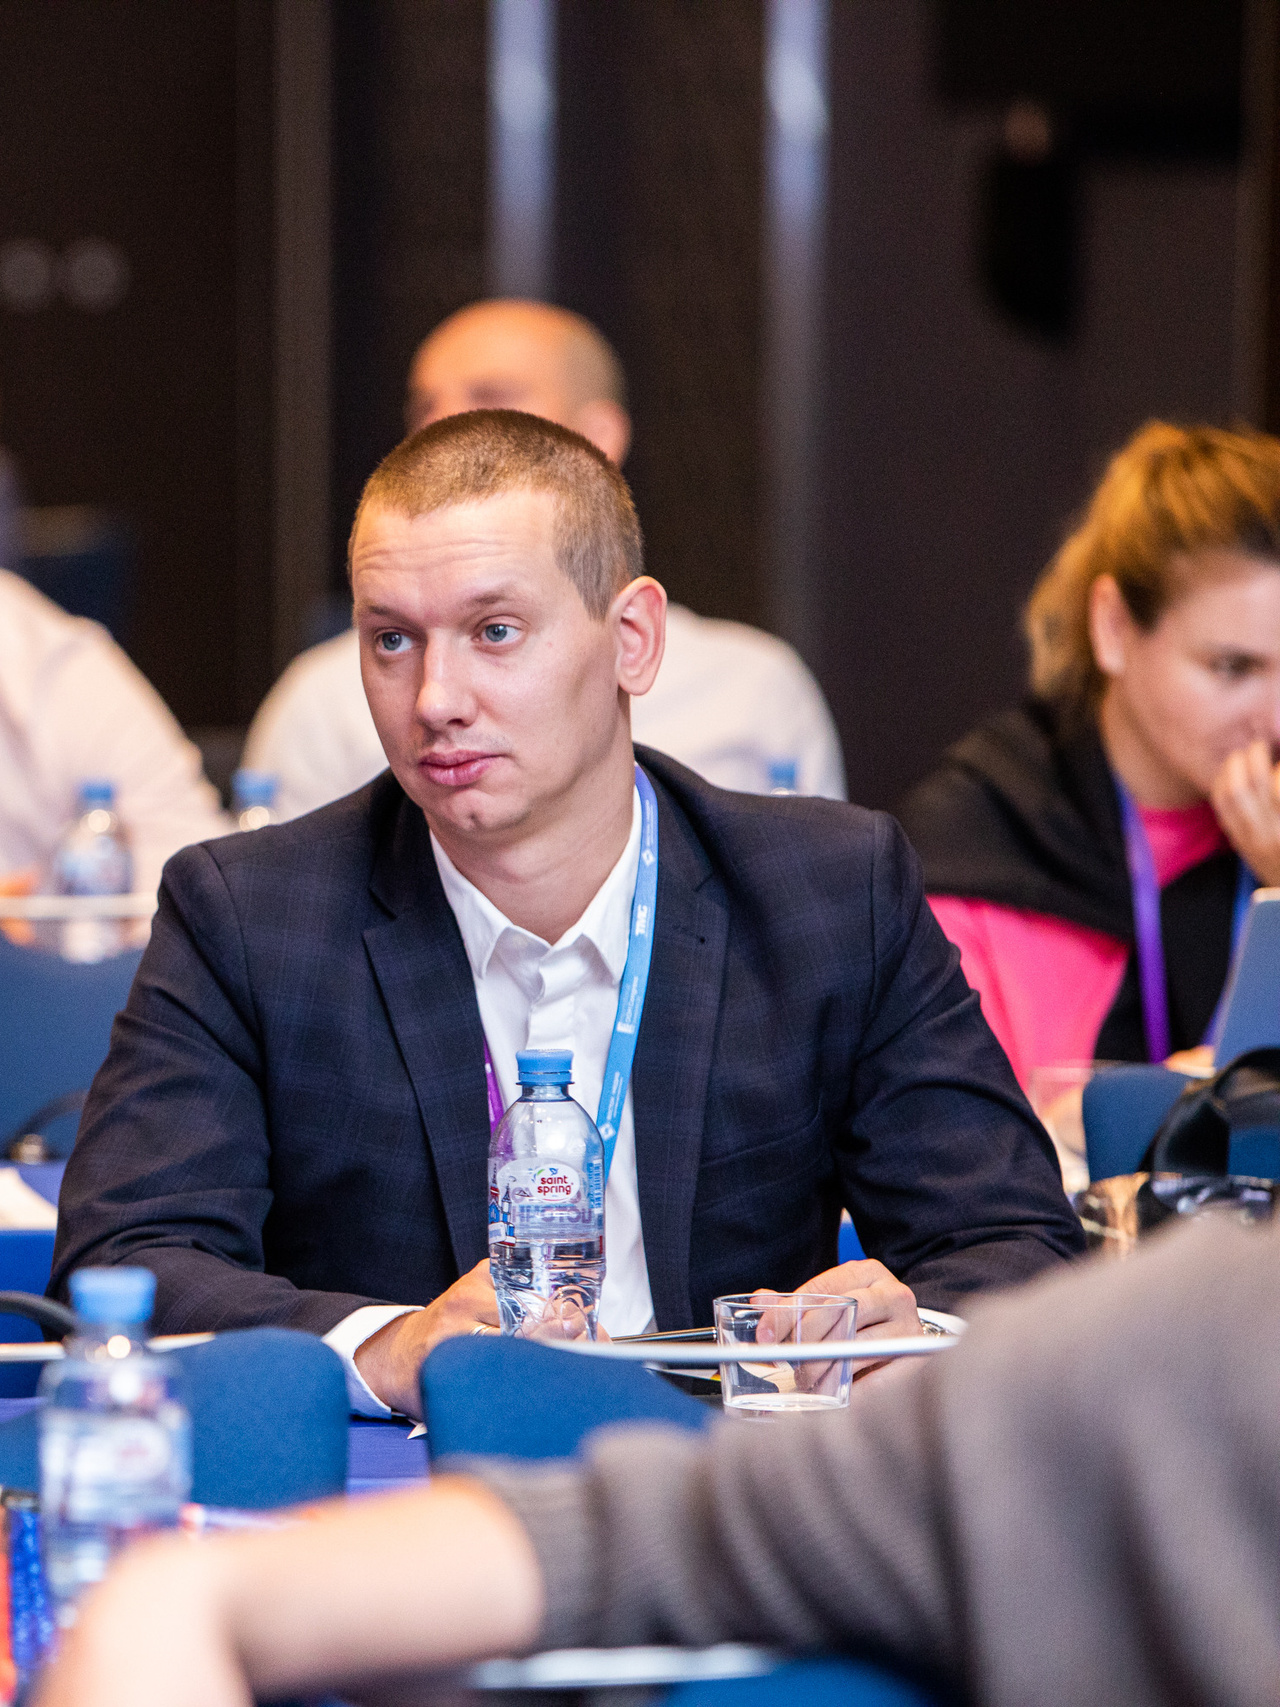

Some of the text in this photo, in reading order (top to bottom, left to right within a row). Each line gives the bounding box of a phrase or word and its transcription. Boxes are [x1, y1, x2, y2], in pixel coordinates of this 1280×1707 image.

[635, 904, 648, 937] TMG
[540, 1175, 568, 1185] saint
[537, 1184, 571, 1196] spring
